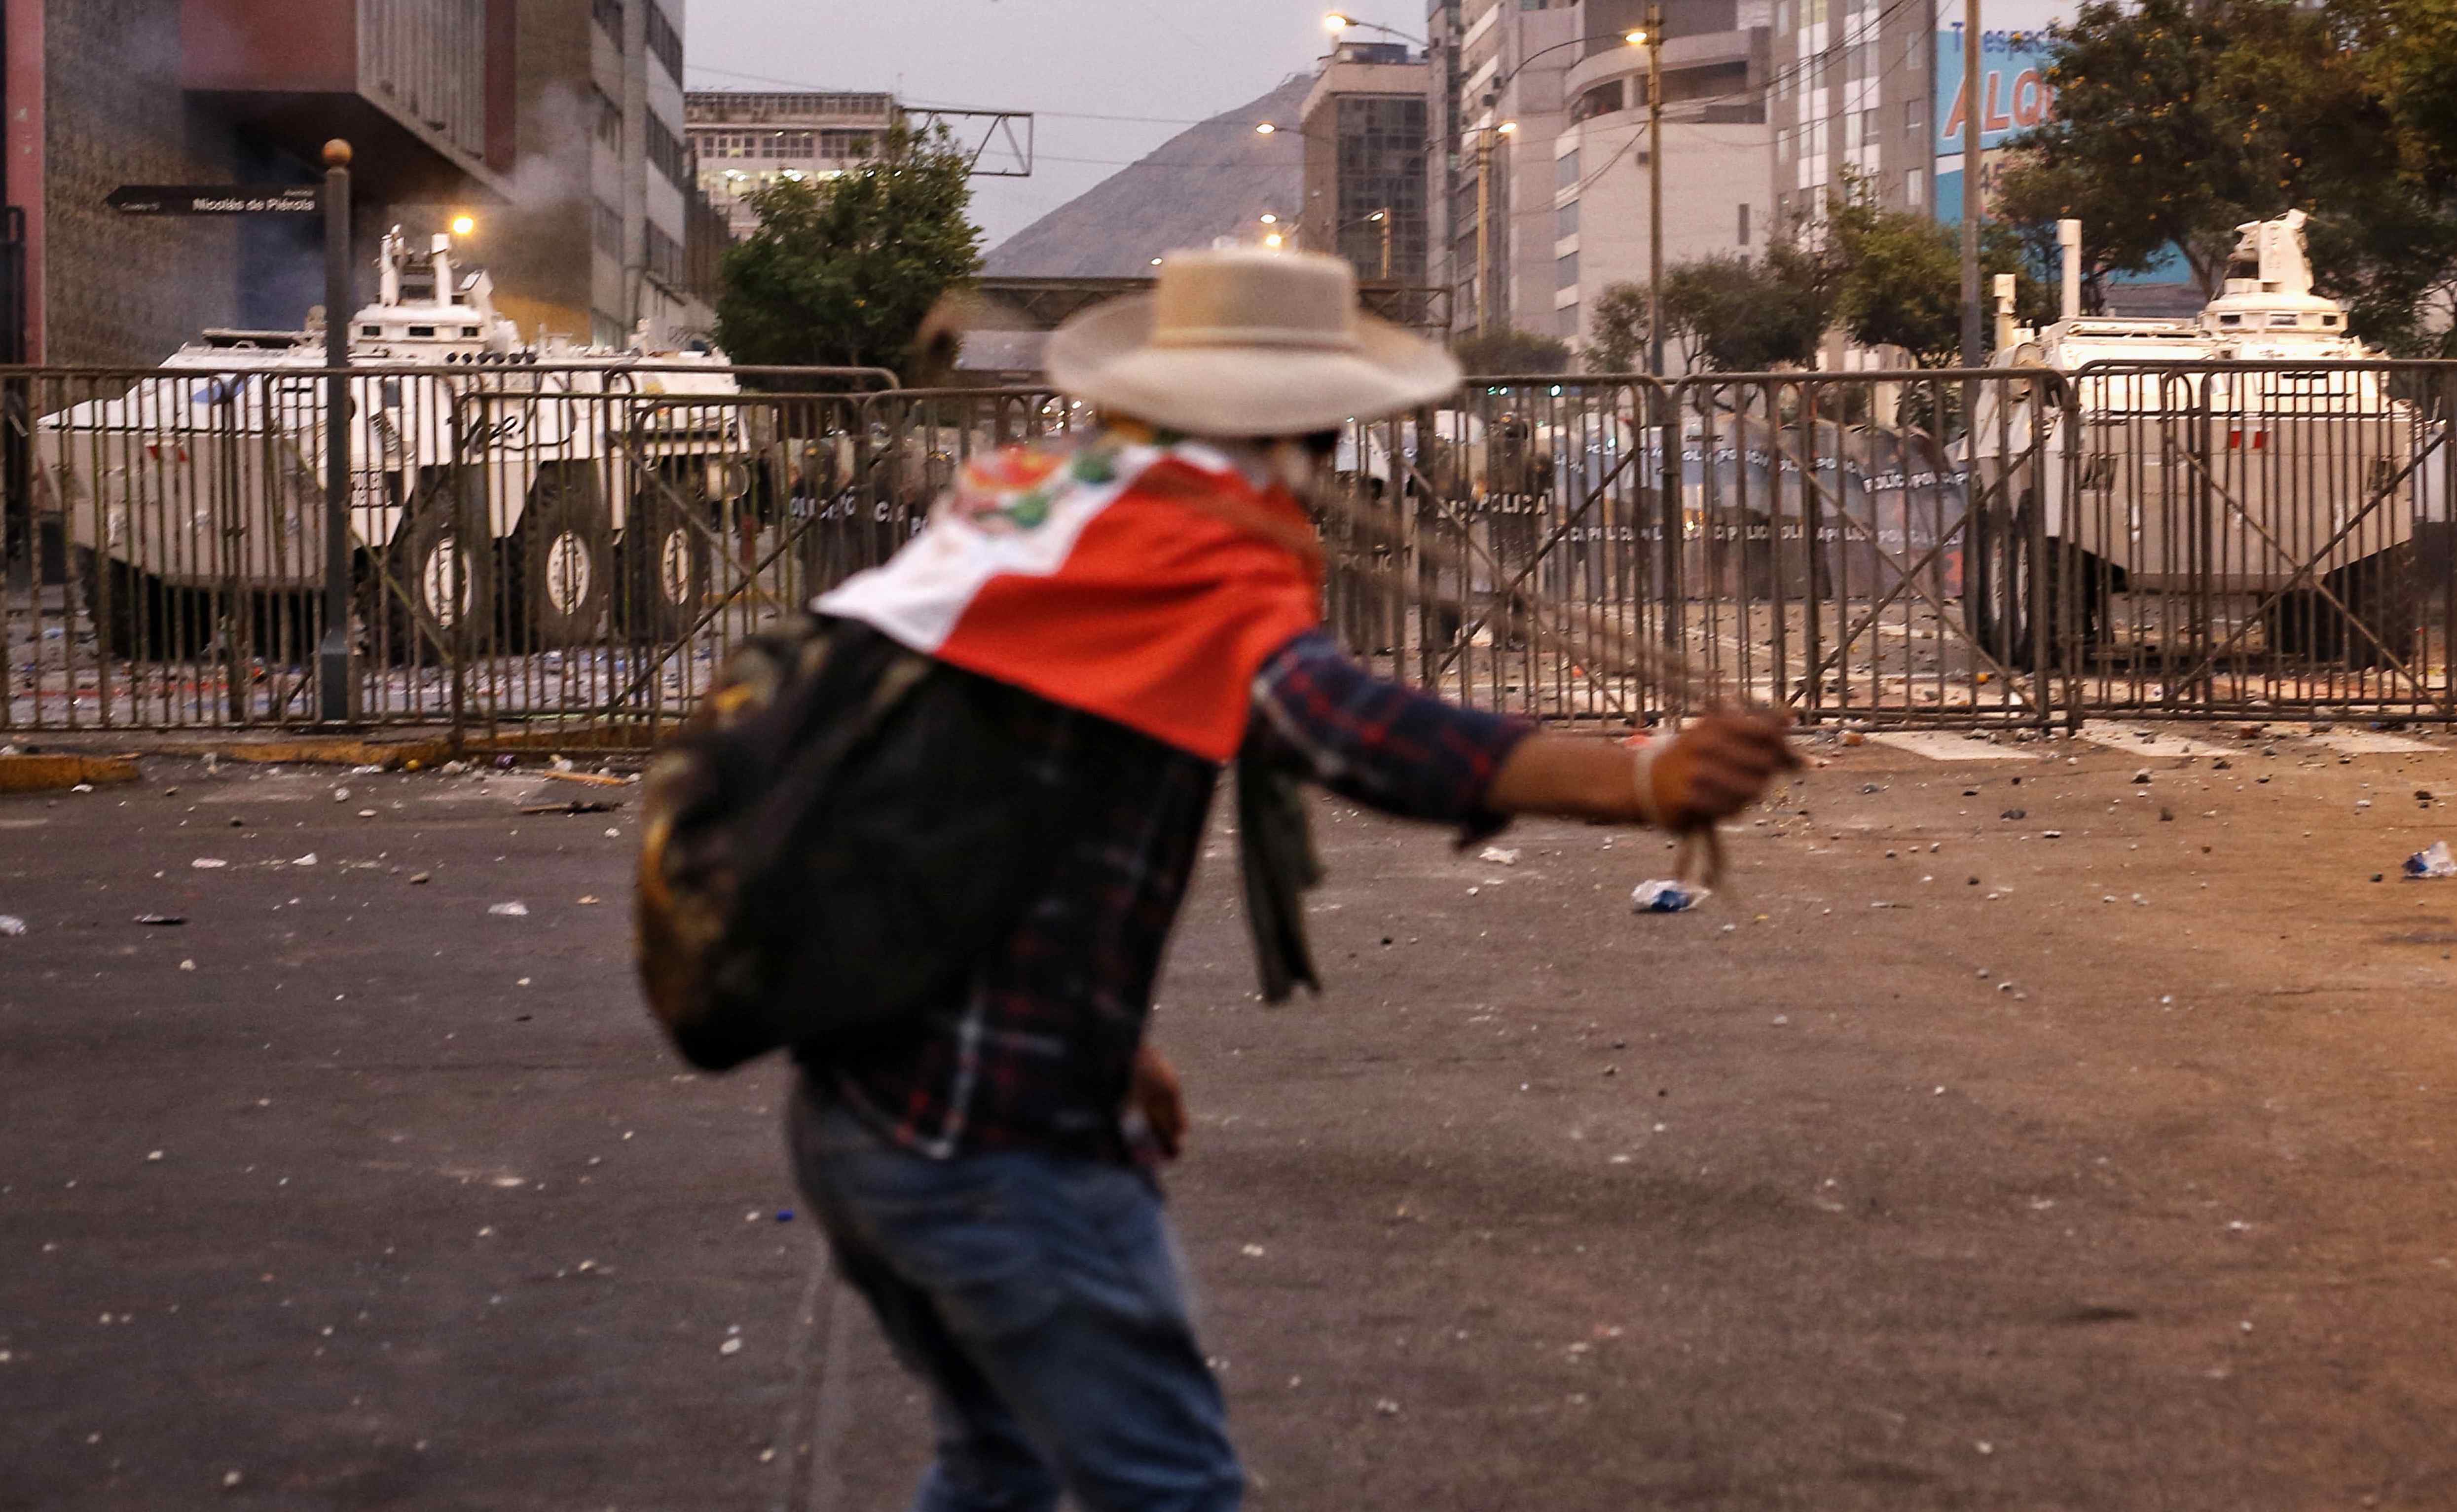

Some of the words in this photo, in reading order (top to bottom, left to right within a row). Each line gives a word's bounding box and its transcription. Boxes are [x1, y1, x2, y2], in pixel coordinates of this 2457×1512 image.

[192, 198, 245, 211] Nicolás
[246, 199, 265, 211] de
[266, 198, 315, 212] Piérola
